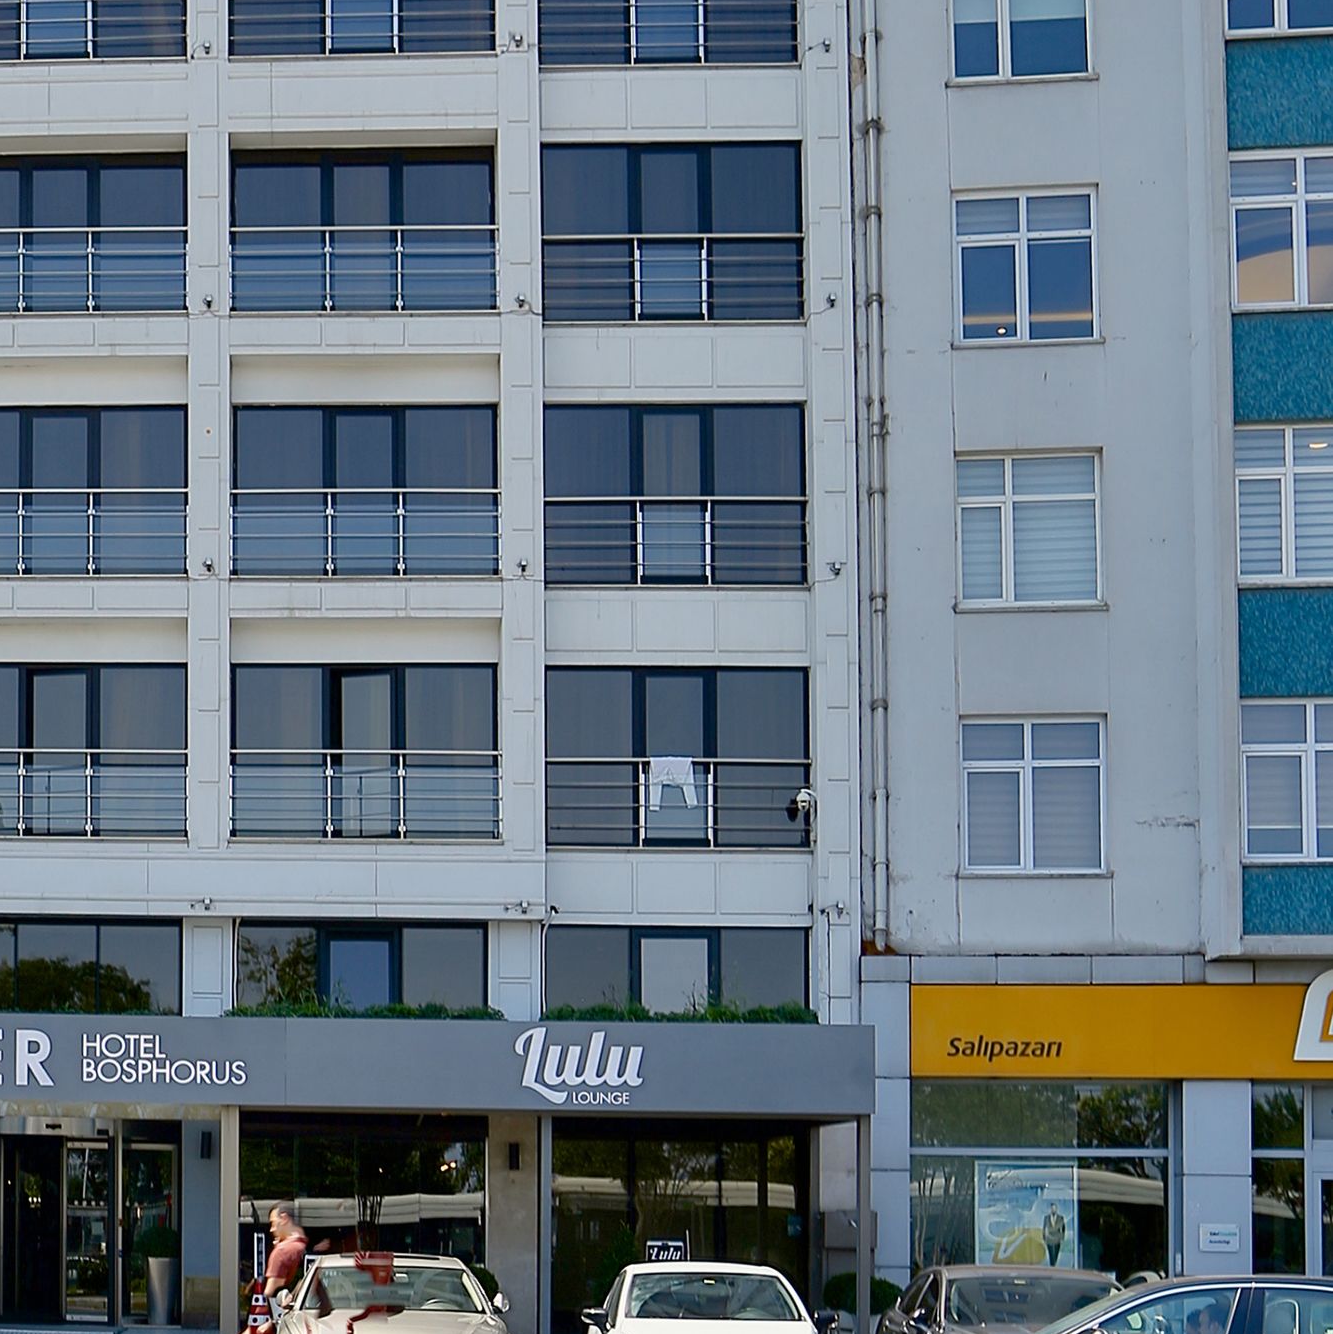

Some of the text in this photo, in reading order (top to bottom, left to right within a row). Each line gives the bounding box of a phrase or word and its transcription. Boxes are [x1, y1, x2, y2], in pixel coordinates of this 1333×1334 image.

[81, 1033, 166, 1060] HOTEL
[81, 1057, 247, 1086] BOSPHORUS
[514, 1026, 644, 1105] Lulu
[571, 1091, 631, 1106] LOUNGE
[649, 1247, 681, 1261] Lulu
